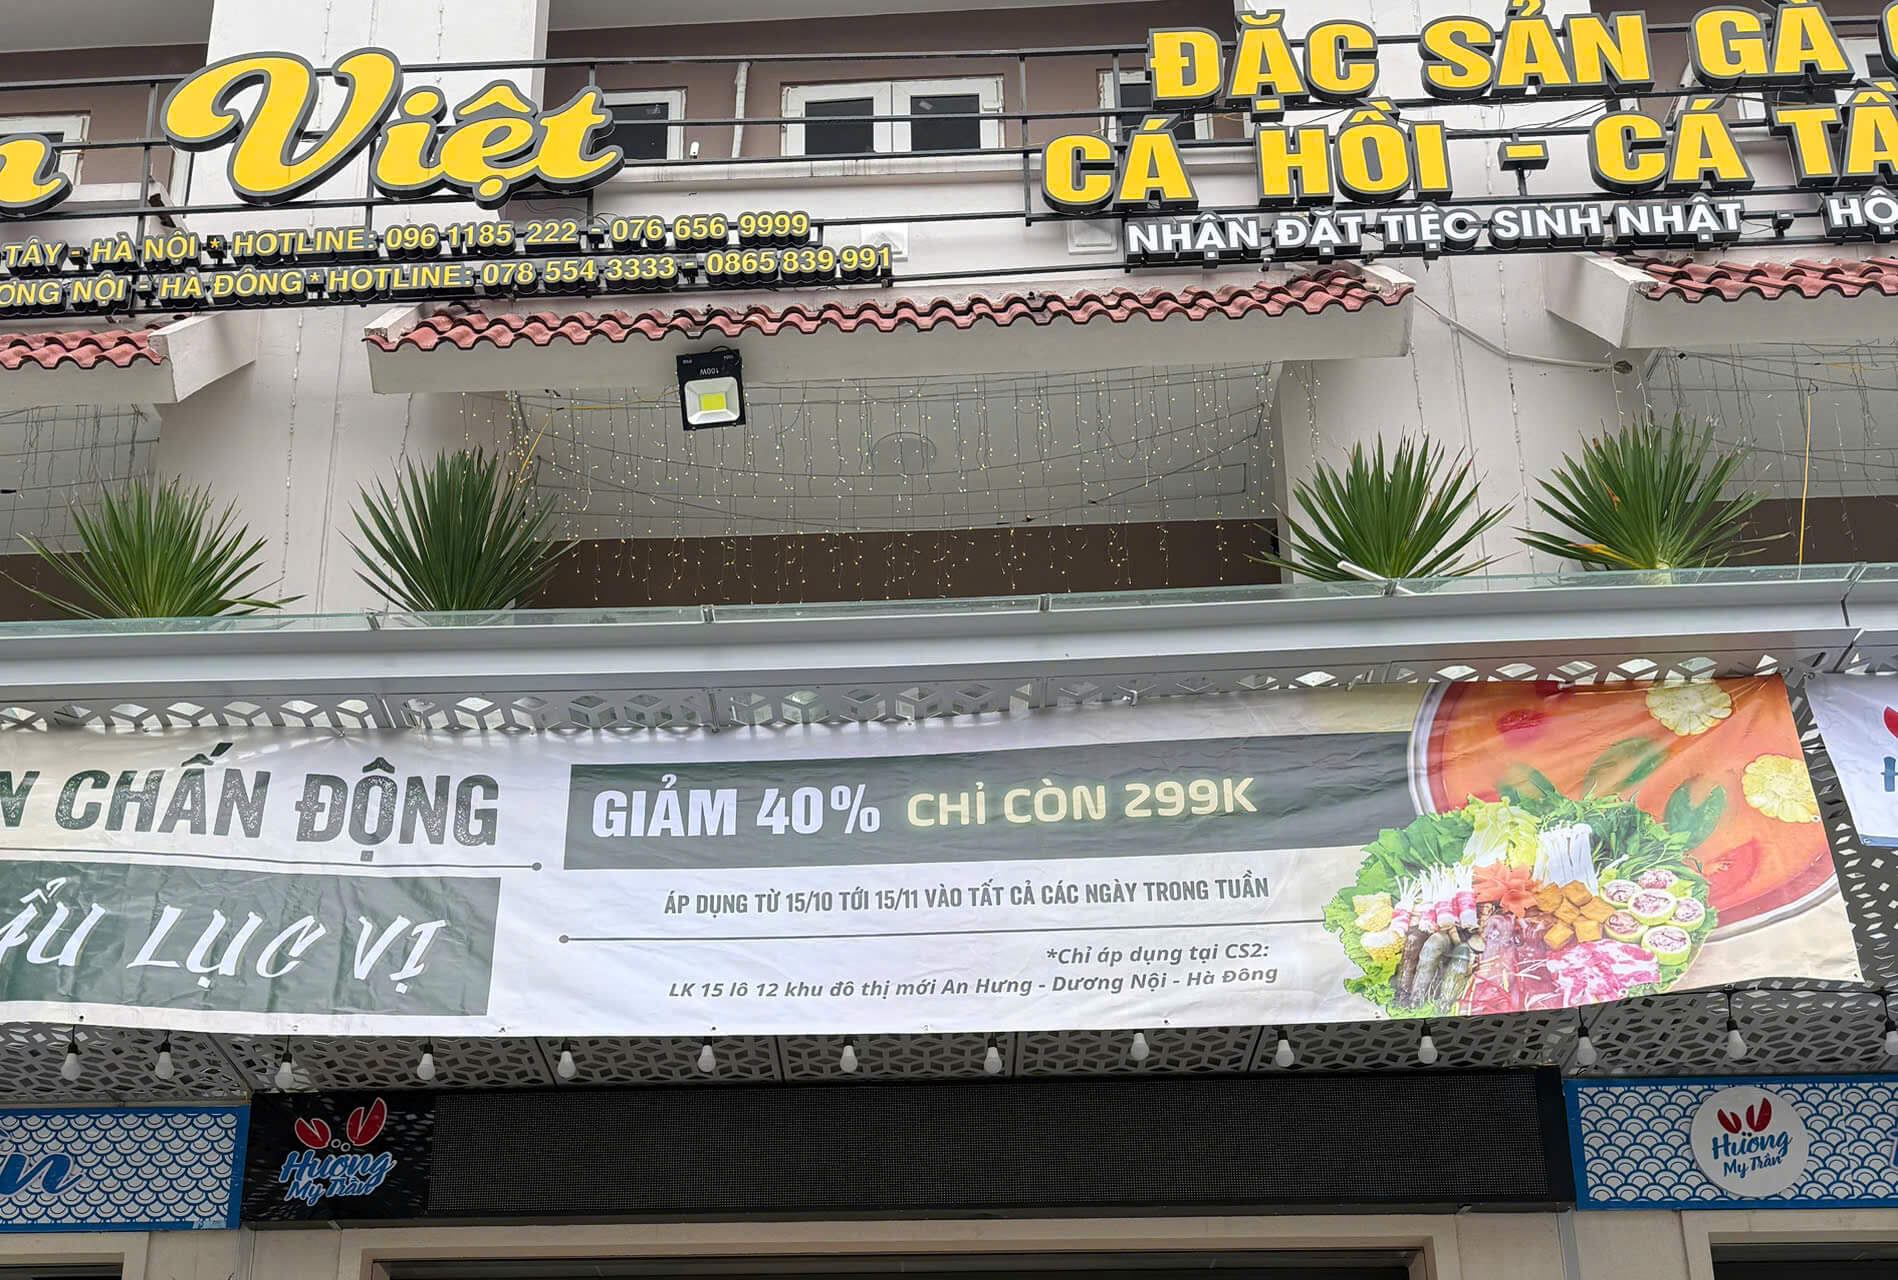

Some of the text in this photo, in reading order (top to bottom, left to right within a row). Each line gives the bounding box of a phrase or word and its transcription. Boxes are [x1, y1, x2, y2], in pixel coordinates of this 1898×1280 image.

[1148, 10, 1380, 111] ĐẶC
[1421, 0, 1653, 90] SẢN
[160, 47, 624, 208] Việt
[1044, 117, 1197, 205] CÁ
[1259, 99, 1449, 197] HỒI
[1592, 97, 1752, 185] CÁ
[5, 238, 63, 266] TÂY
[91, 233, 134, 263] HÀ
[144, 231, 199, 263] NỘI
[233, 228, 376, 257] HOTLINE:
[387, 226, 437, 249] 096
[448, 222, 513, 247] 1185
[526, 221, 578, 244] 222
[611, 218, 663, 241] 076
[674, 216, 727, 239] 656
[739, 213, 809, 237] 9999
[1127, 214, 1258, 259] NHẬN
[1276, 209, 1362, 254] ĐẶT
[1381, 205, 1480, 249] TIỆC
[1494, 207, 1599, 238] SINH
[1618, 196, 1741, 240] NHẬT
[71, 273, 127, 303] NỘI
[160, 271, 202, 299] HÀ
[213, 267, 302, 297] ĐÔNG
[328, 265, 474, 291] HOTLINE:
[482, 262, 535, 286] 078
[544, 260, 596, 282] 554
[606, 257, 675, 280] 3333
[706, 250, 777, 274] 0865
[782, 249, 835, 271] 839
[841, 247, 890, 269] 991
[55, 742, 272, 838] CHẤN
[294, 756, 499, 863] ĐỘNG
[592, 774, 1259, 838] GIẢM 40% CHỈ CÒN 299K
[664, 869, 1270, 919] ÁP DỤNG TỪ 15/10 TỚI 15/11 VÀO TẤT CẢ CÁC NGÀY TRONG TUẦN
[127, 904, 327, 990] LỤC
[354, 912, 448, 994] VỊ
[1097, 946, 1123, 967] áp
[1129, 945, 1183, 966] dụng
[1189, 943, 1218, 964] tại
[1224, 942, 1270, 960] CS2:
[668, 982, 695, 998] LK
[701, 982, 724, 998] 15
[729, 981, 749, 998] lô
[756, 982, 779, 998] 12
[784, 981, 825, 998] khu
[830, 980, 855, 997] đô
[861, 980, 890, 1000] thị
[895, 979, 936, 996] mới
[941, 978, 969, 995] An
[975, 977, 1033, 997] Hưng
[1052, 974, 1124, 993] Dương
[1130, 972, 1168, 993] Nội
[1186, 971, 1215, 988] Hà
[1221, 968, 1279, 985] Đông
